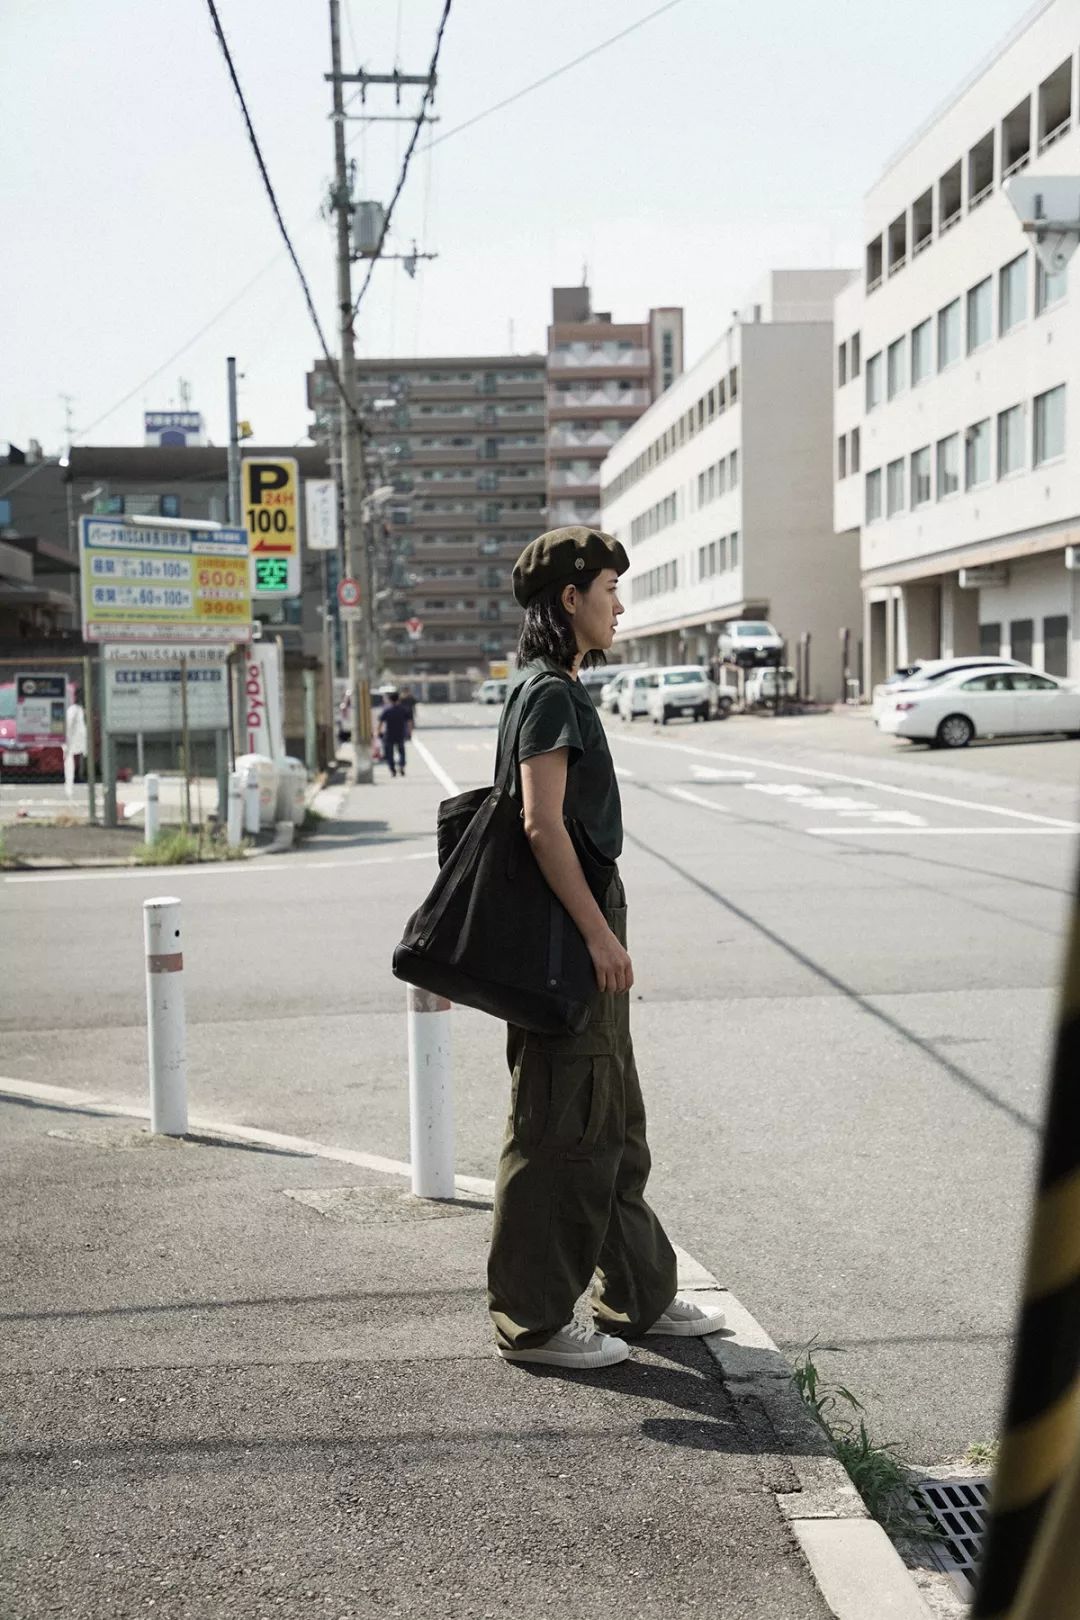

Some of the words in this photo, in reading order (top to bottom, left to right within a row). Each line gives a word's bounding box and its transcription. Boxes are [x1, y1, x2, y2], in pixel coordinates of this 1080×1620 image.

[249, 464, 289, 504] P
[265, 492, 294, 506] 24H
[245, 665, 266, 728] DyDo
